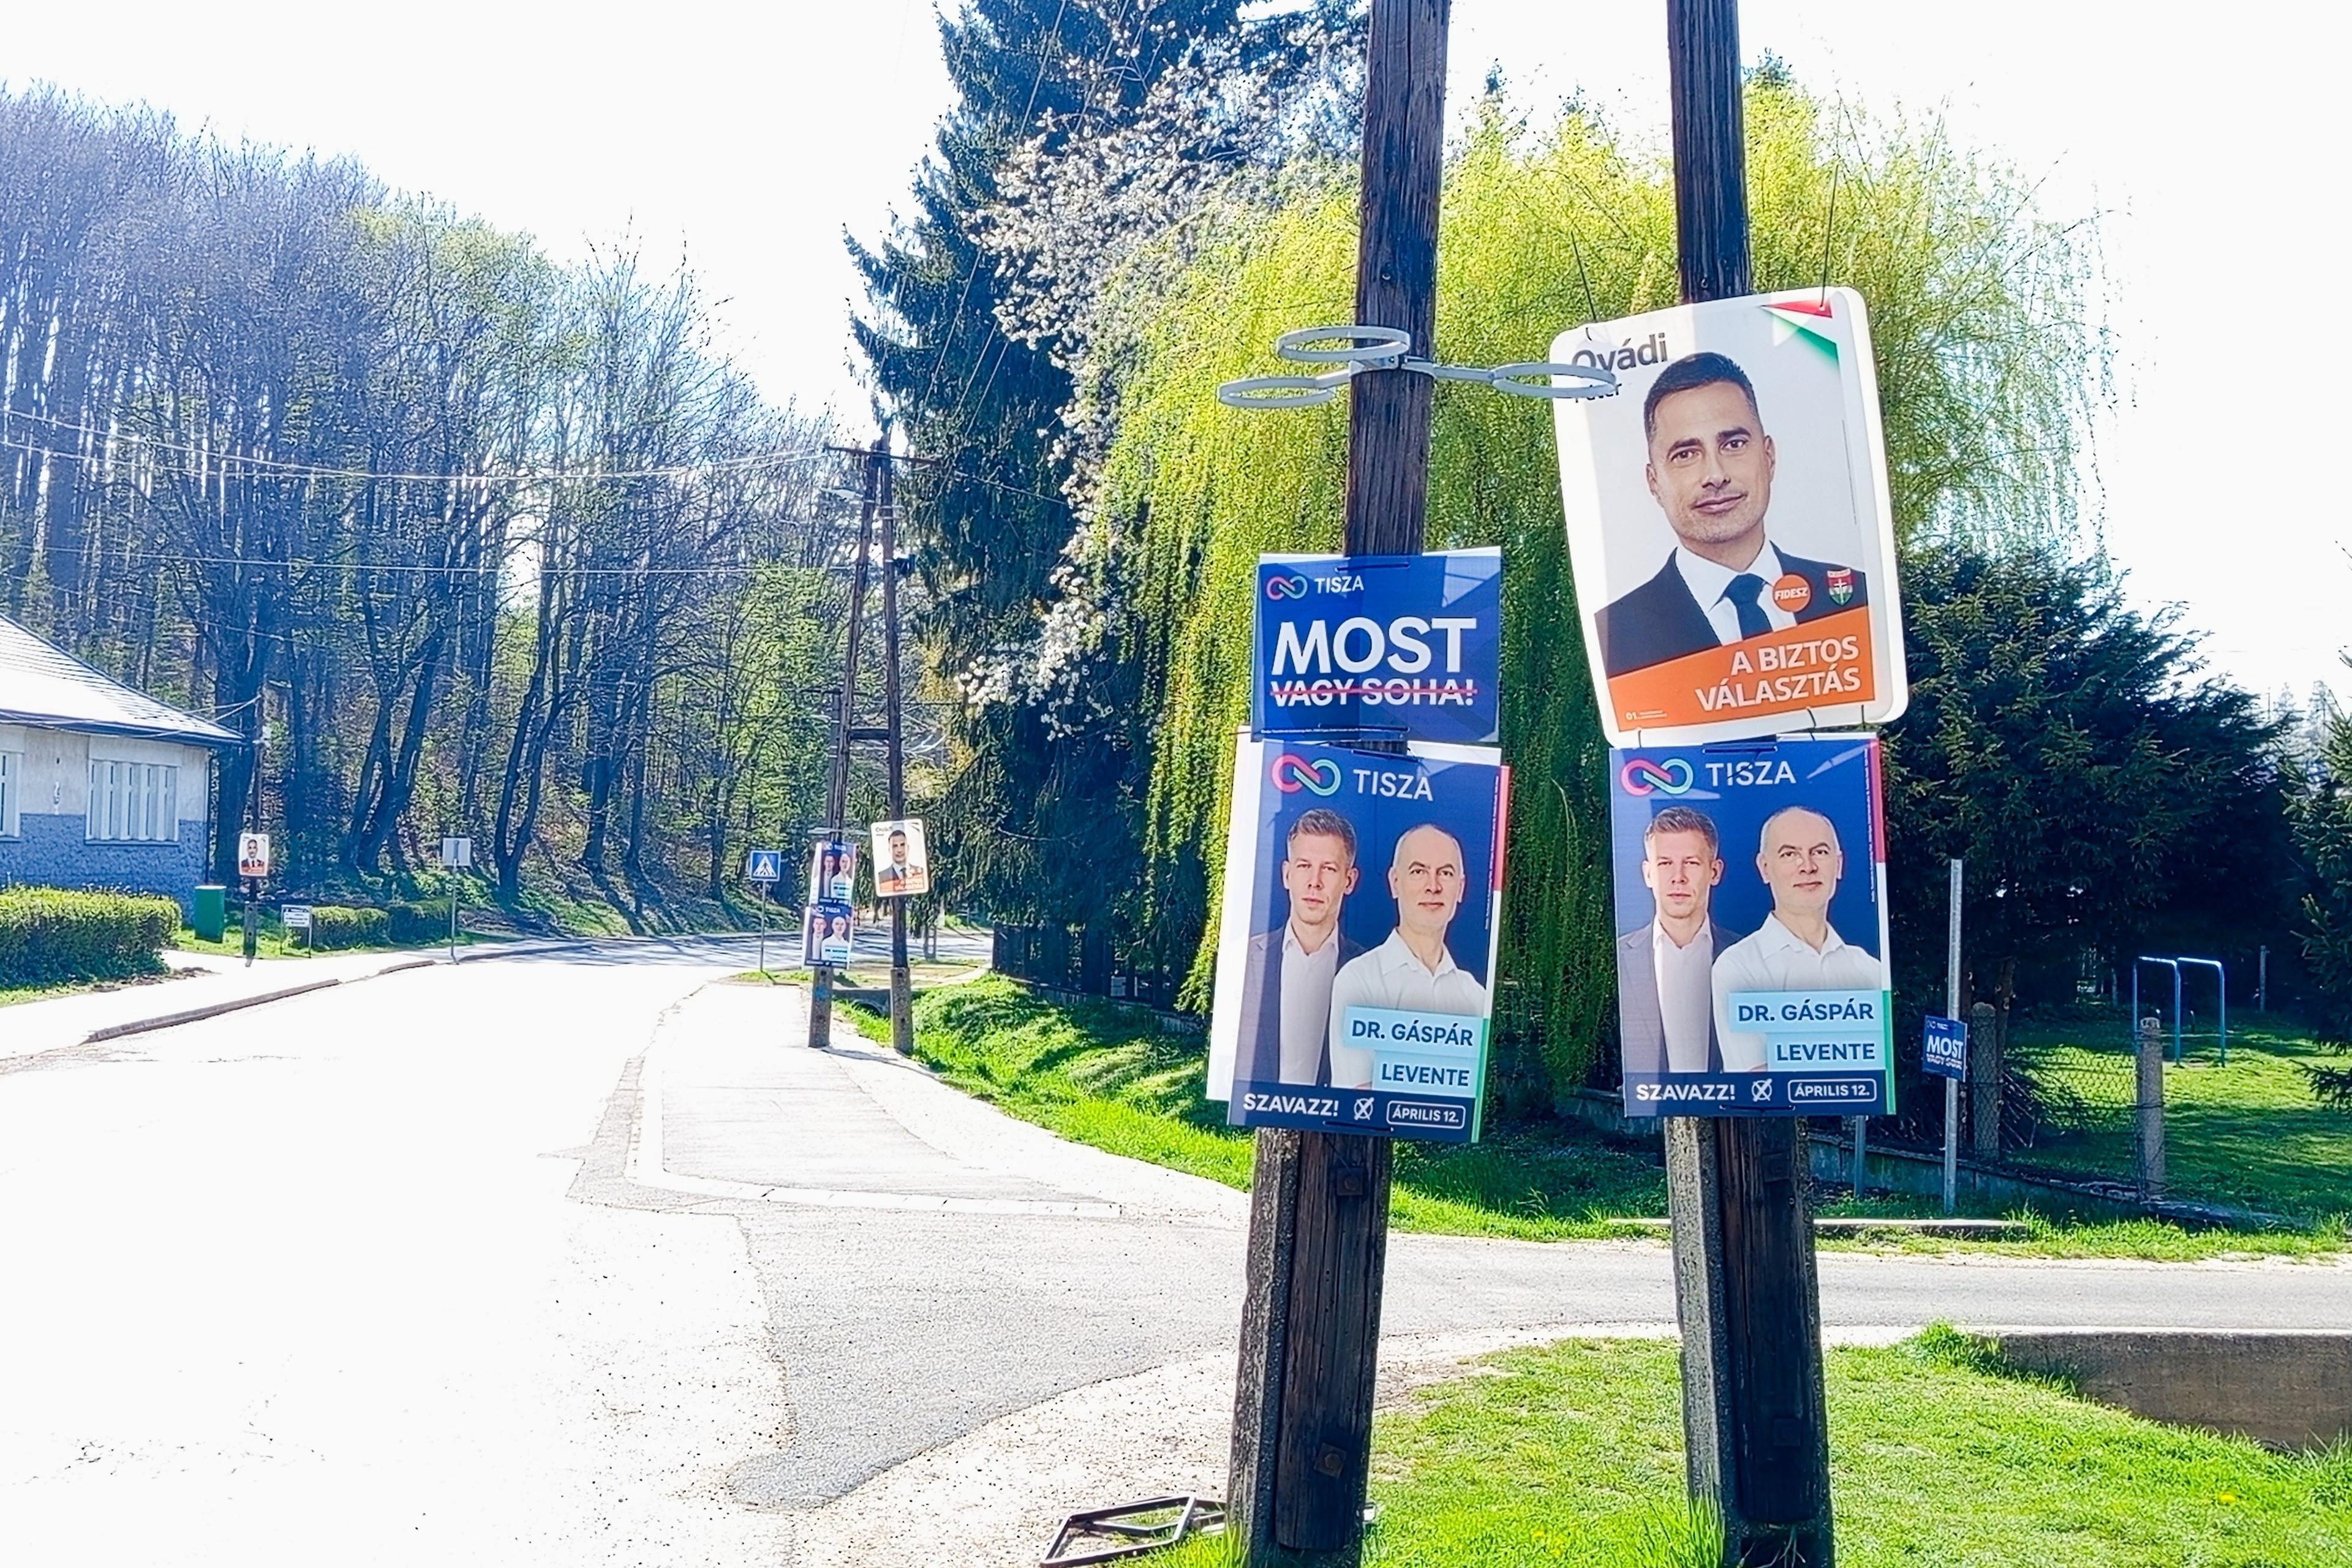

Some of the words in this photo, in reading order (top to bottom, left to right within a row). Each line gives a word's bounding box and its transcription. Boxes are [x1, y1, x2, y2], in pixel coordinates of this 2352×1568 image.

[1314, 576, 1364, 594] TISZA
[1774, 587, 1809, 601] FIDESZ
[1271, 616, 1477, 676] MOST
[1730, 650, 1754, 676] A
[1758, 635, 1860, 672] BIZTOS
[1270, 679, 1354, 707] VAGY
[1361, 677, 1474, 706] SOHA!
[1694, 663, 1861, 712] VÁLASZTÁS
[1352, 768, 1433, 802] TISZA
[1705, 760, 1796, 786] TISZA
[1738, 1005, 1776, 1022] DR.
[1781, 998, 1874, 1021] GÁSPÁR
[1351, 1019, 1385, 1039] DR.
[1391, 1019, 1474, 1047] GÁSPÁR
[1776, 1042, 1875, 1061] LEVENTE
[1926, 1034, 1964, 1060] MOST
[1381, 1063, 1471, 1087] LEVENTE
[1635, 1083, 1735, 1101] SZAVAZZ!
[1794, 1082, 1849, 1097] ÁPRILIS
[1852, 1084, 1870, 1096] 12.
[1243, 1092, 1339, 1117] SZAVAZZ!
[1392, 1104, 1441, 1122] ÁPRILIS
[1443, 1110, 1459, 1123] 12.
